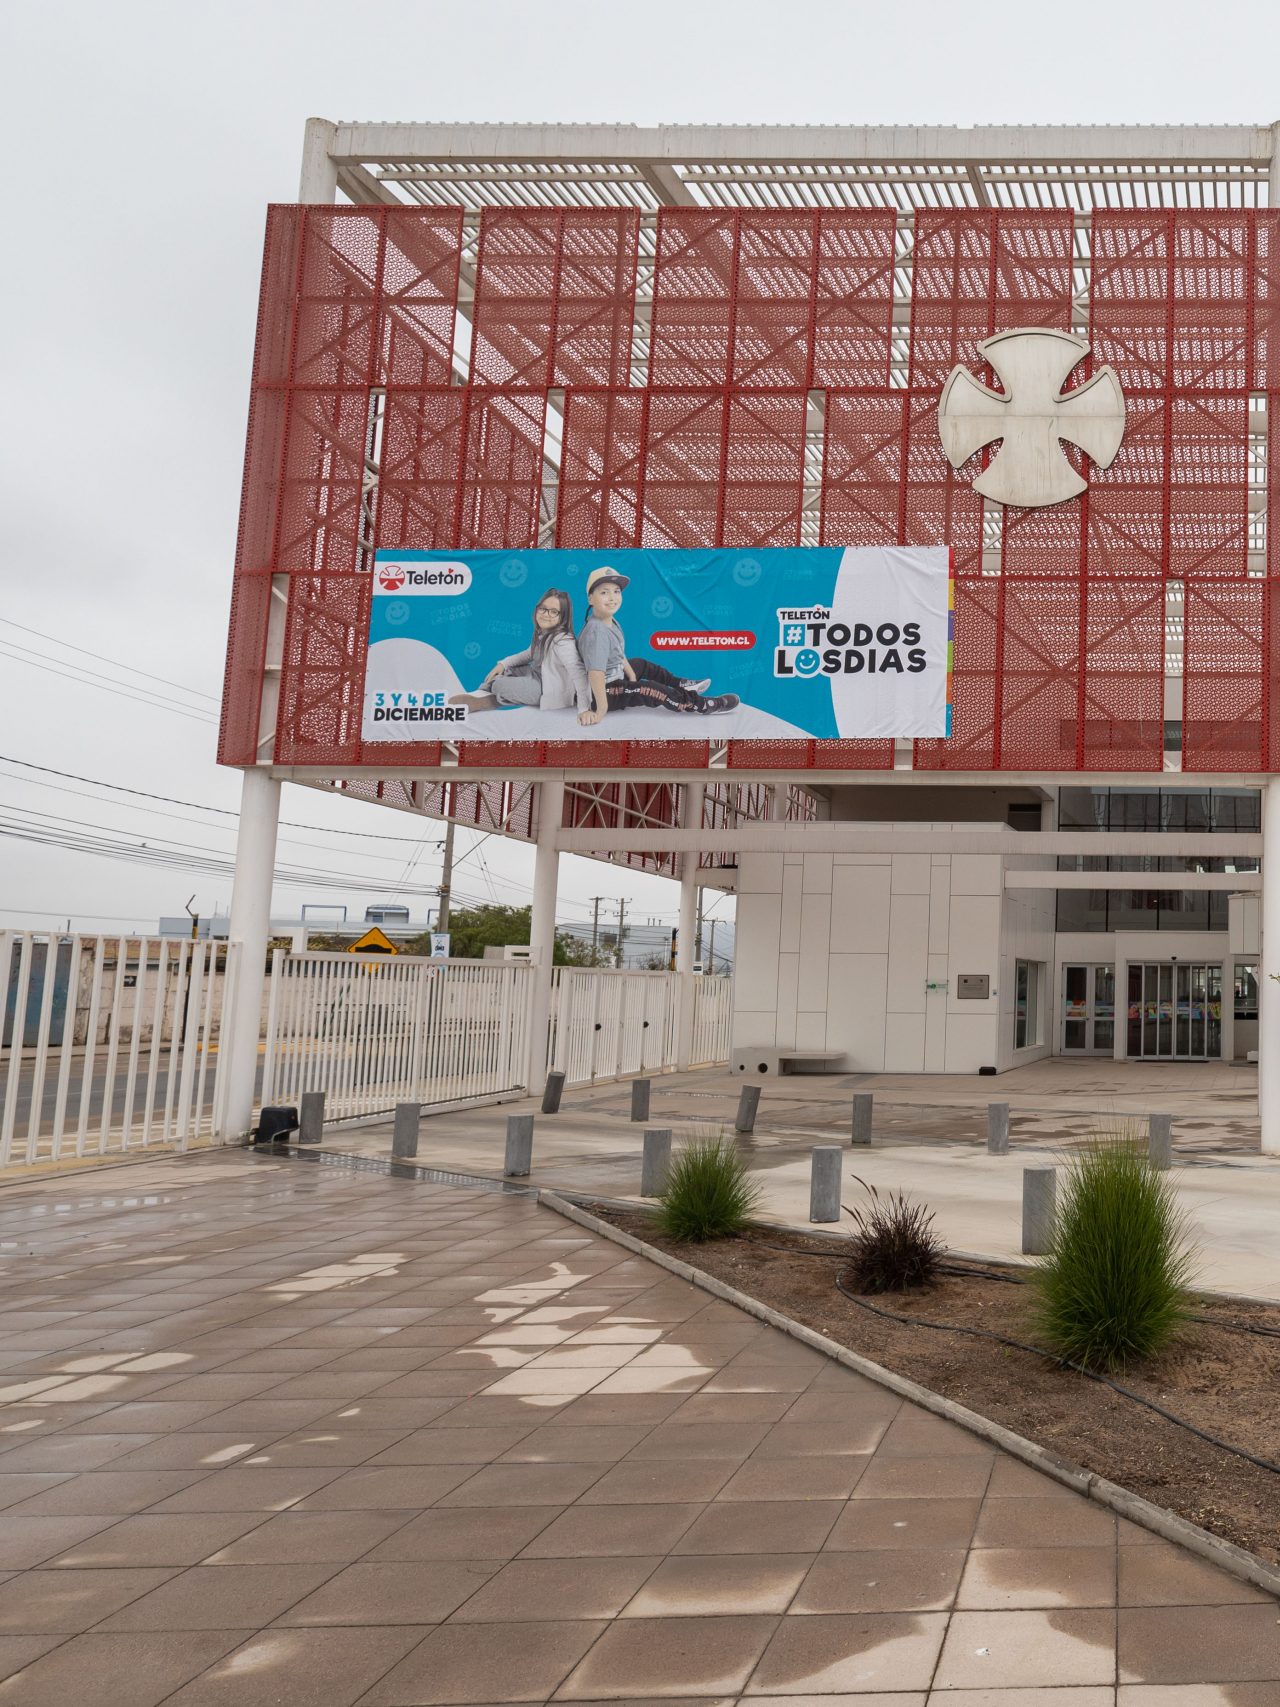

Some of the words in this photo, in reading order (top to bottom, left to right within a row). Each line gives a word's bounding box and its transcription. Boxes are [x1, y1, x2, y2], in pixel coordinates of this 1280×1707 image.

[406, 568, 464, 585] Teletón
[656, 636, 750, 646] WWW.TELETON.CL
[784, 622, 921, 647] #TODOS
[375, 693, 385, 706] 3
[391, 693, 402, 706] Y
[408, 693, 418, 706] 4
[423, 693, 445, 706] DE
[374, 707, 466, 722] DICIEMBRE
